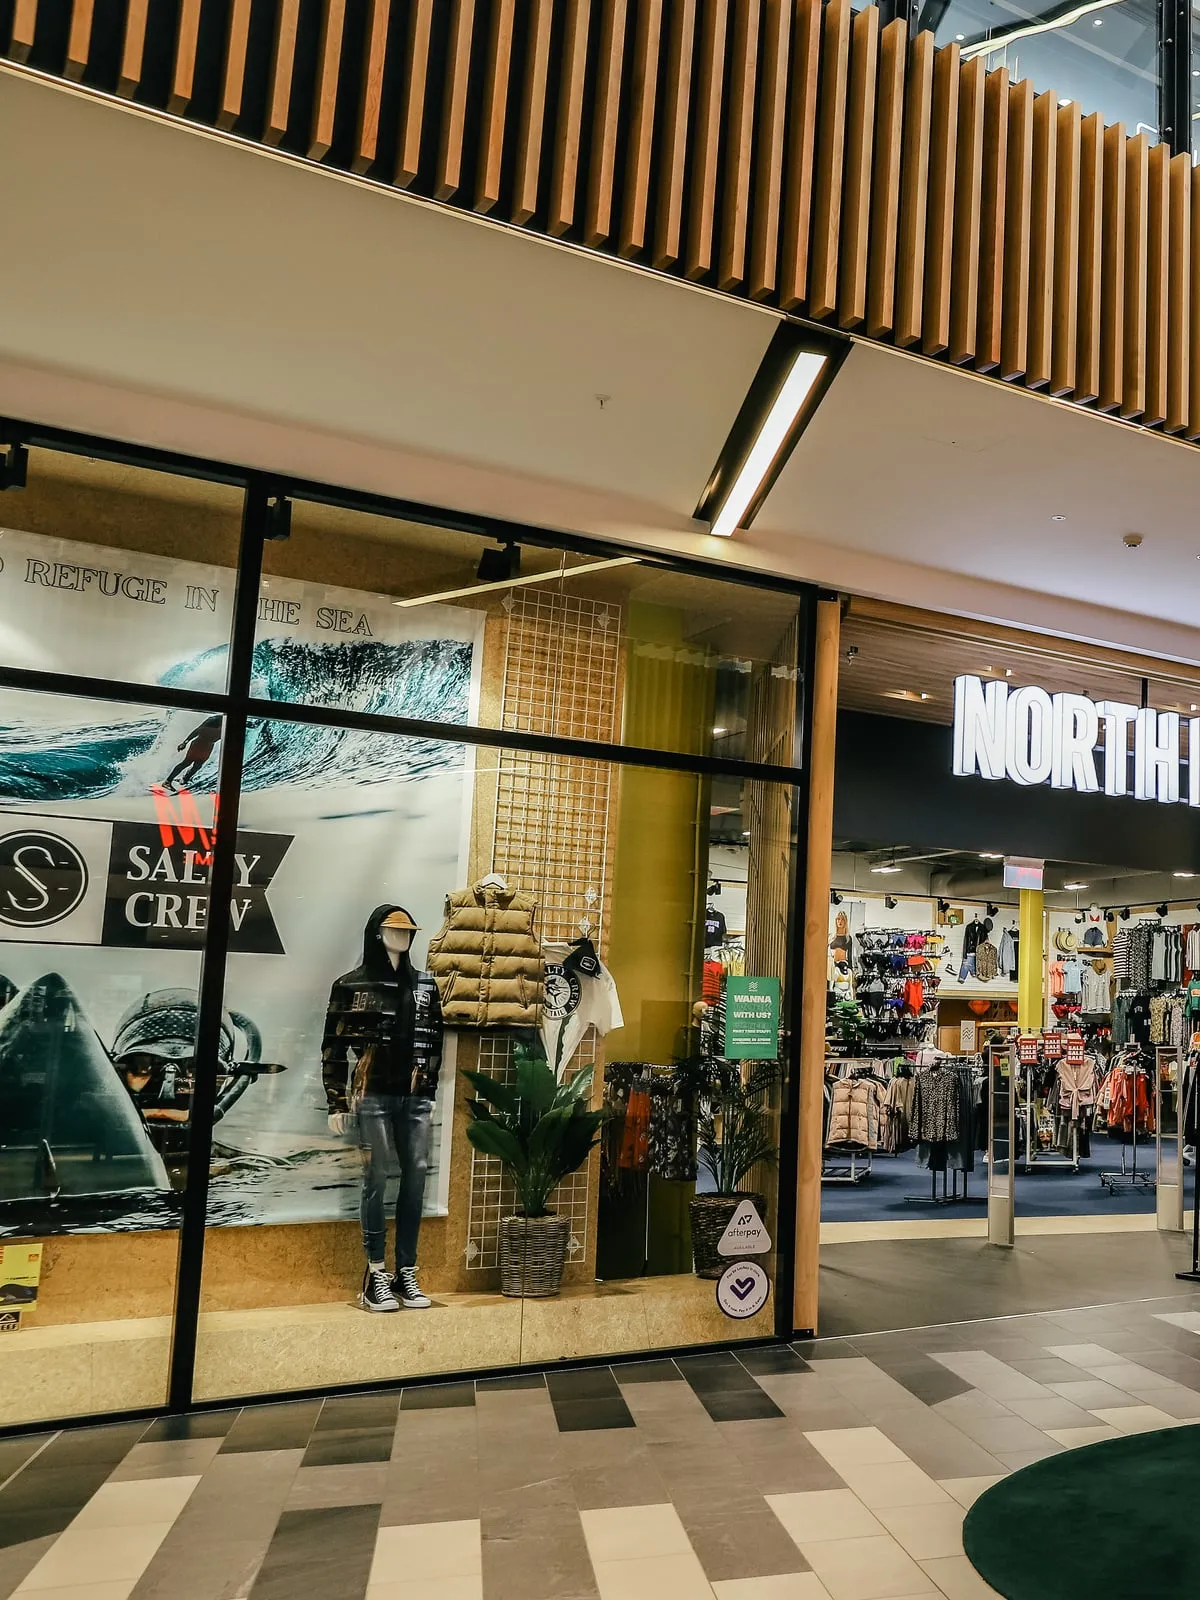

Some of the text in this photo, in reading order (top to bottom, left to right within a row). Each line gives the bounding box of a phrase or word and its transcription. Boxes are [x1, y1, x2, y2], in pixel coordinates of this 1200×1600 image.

[24, 558, 167, 605] REFUGE
[184, 585, 220, 612] IN
[258, 597, 301, 626] HE
[316, 607, 374, 636] SEA
[952, 674, 1179, 803] NORTH
[126, 845, 261, 888] SALY
[733, 994, 772, 1004] WANNA
[733, 1011, 772, 1019] WITH US?
[727, 1227, 762, 1239] afterpay
